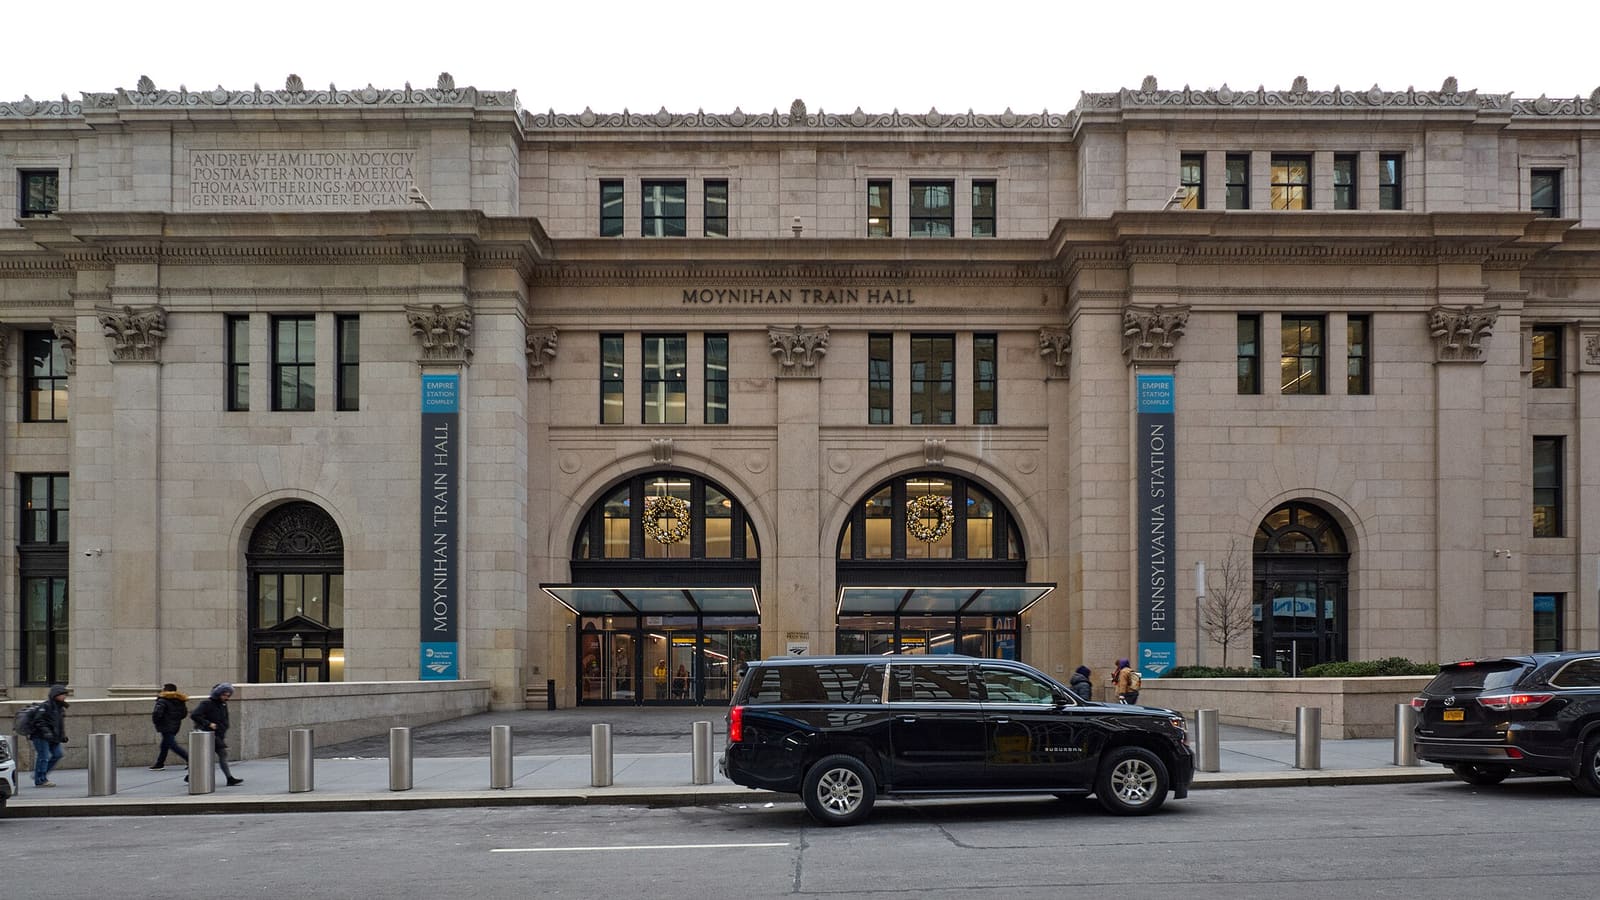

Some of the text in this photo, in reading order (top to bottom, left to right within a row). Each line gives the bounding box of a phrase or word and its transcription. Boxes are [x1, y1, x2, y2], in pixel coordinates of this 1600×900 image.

[193, 153, 260, 167] ANDREW
[266, 153, 346, 167] HAMILTON
[194, 167, 414, 180] POSTMASTER NORTH AMERICA
[192, 181, 249, 193] THOMAS
[251, 181, 340, 193] WITHERINGS
[192, 194, 256, 206] GENERAL
[260, 194, 347, 206] POSTMASTER
[682, 289, 916, 304] MOYNIHAN TRAIN HALL
[426, 382, 454, 390] EMPIRE
[1142, 382, 1169, 390] EMPIRE
[433, 422, 448, 632] MOYNIHAN TRAIN HALL
[1150, 424, 1165, 631] PENNSYLVANIA STATION
